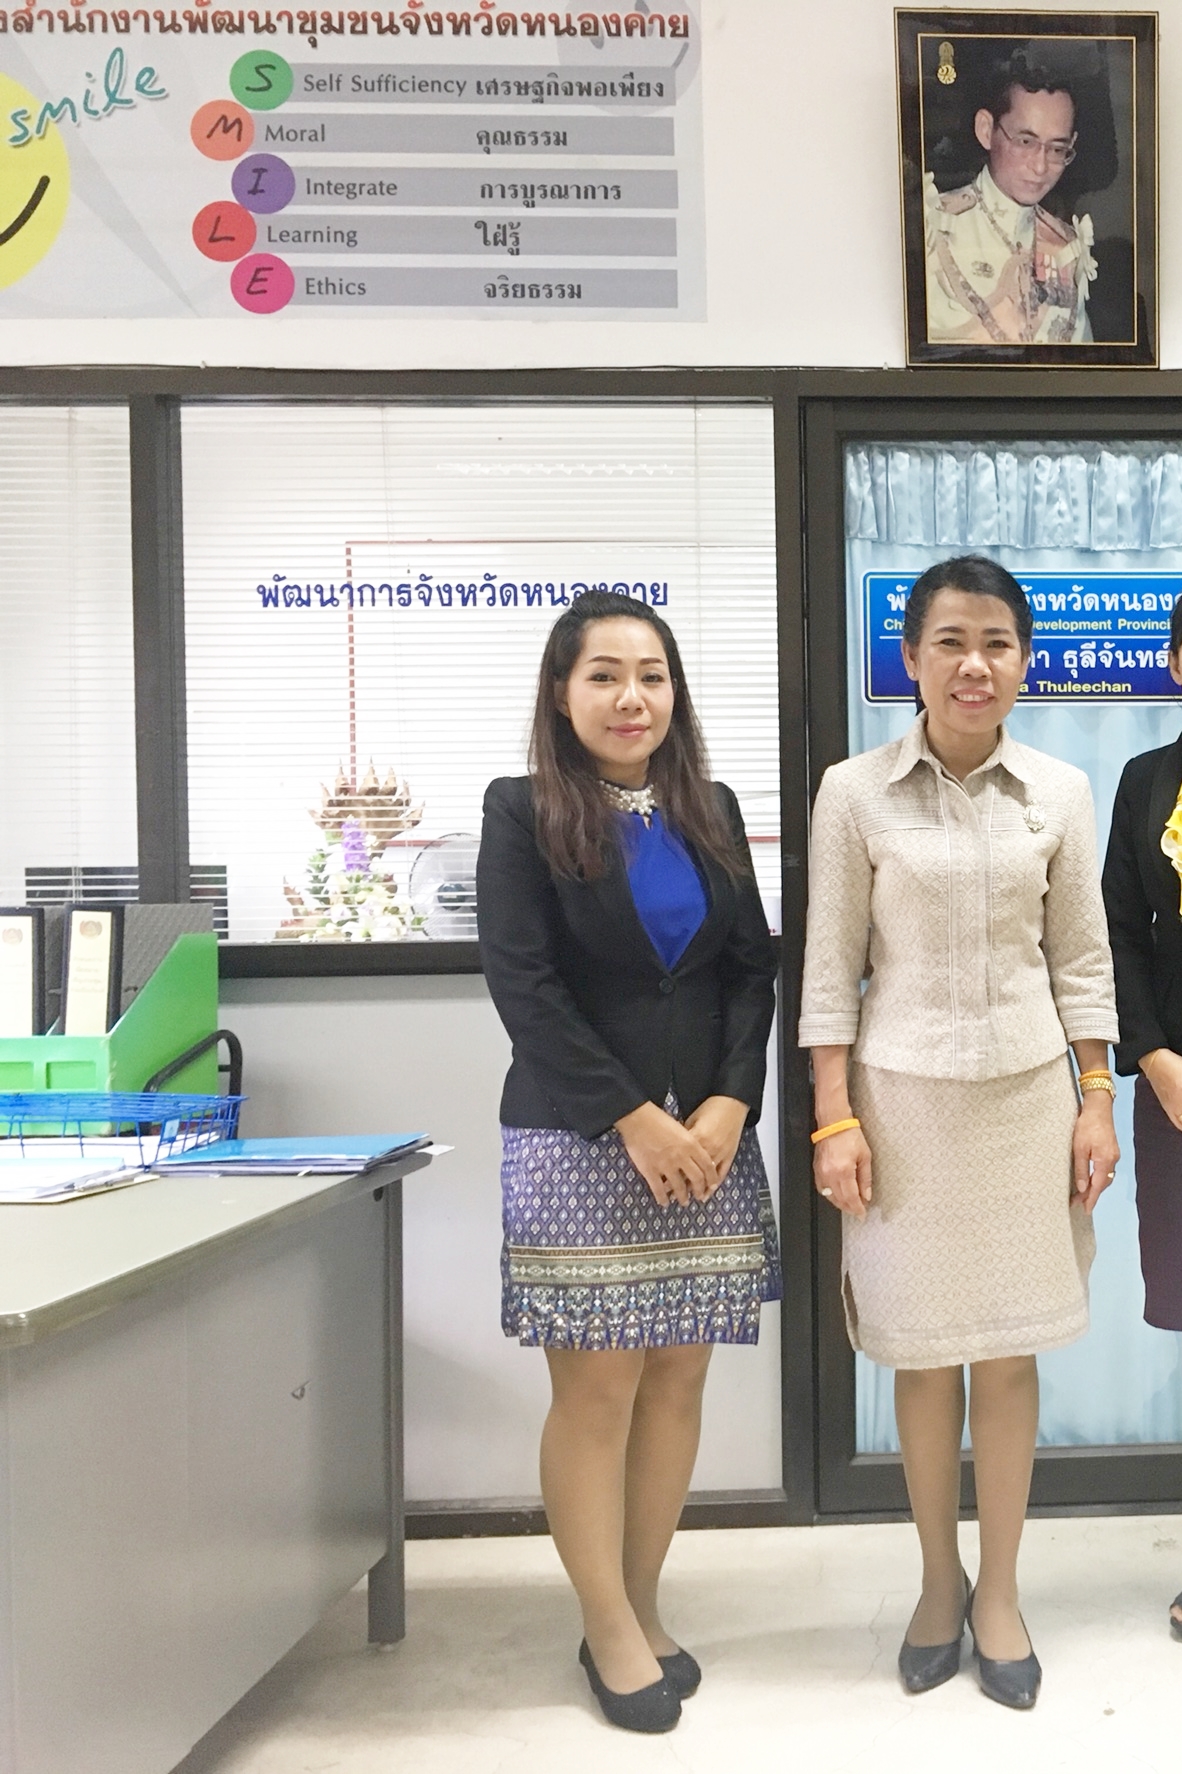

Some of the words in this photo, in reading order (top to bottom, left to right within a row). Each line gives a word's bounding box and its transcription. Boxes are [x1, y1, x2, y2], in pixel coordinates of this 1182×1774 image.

[9, 47, 165, 142] smile
[245, 64, 276, 92] S
[303, 74, 342, 92] Self
[351, 74, 467, 97] Sufficiency
[476, 72, 665, 104] เศรษฐกิจพอเพียง
[206, 114, 243, 142] M
[264, 124, 326, 142] Moral
[476, 129, 568, 155] คุณธรรม
[247, 167, 268, 195] I
[306, 178, 398, 199] Integrate
[480, 183, 622, 208] การบูรณาการ
[208, 215, 235, 243] L
[267, 226, 358, 248] Learning
[474, 220, 521, 256] ใฝ่รู้
[246, 266, 274, 295] E
[305, 277, 367, 295] Ethics
[484, 274, 582, 299] จริยธรรม
[1033, 618, 1112, 633] evelopment
[1036, 681, 1132, 693] Thuleechan
